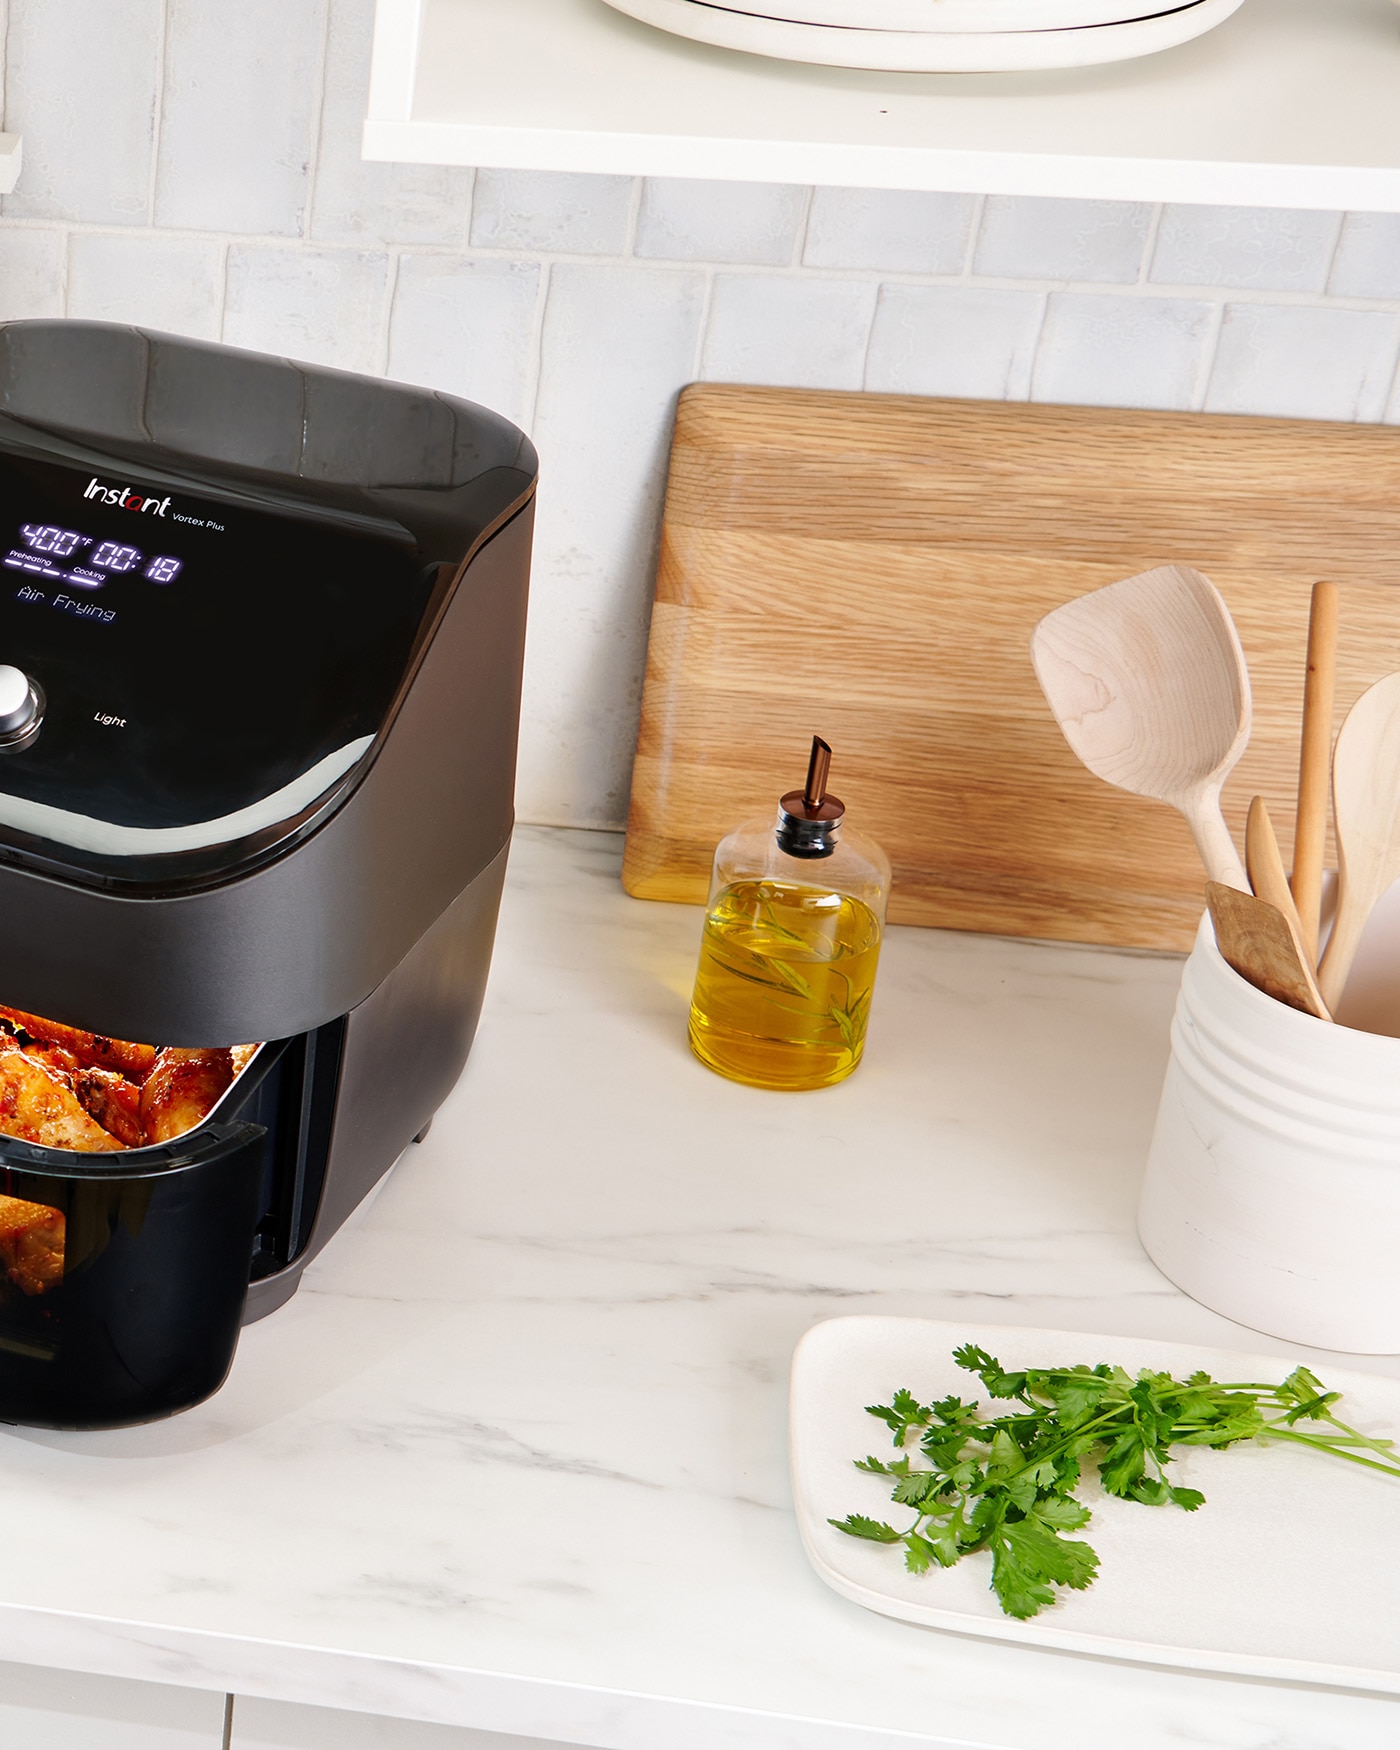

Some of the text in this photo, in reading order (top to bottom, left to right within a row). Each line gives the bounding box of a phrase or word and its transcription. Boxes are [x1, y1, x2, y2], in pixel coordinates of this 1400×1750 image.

[83, 478, 225, 532] Instant Vortex Plus
[9, 550, 53, 567] Preheating
[92, 542, 180, 582] 00:18
[73, 566, 106, 581] Cooking
[17, 585, 117, 621] Air Frying
[93, 712, 127, 728] Light
